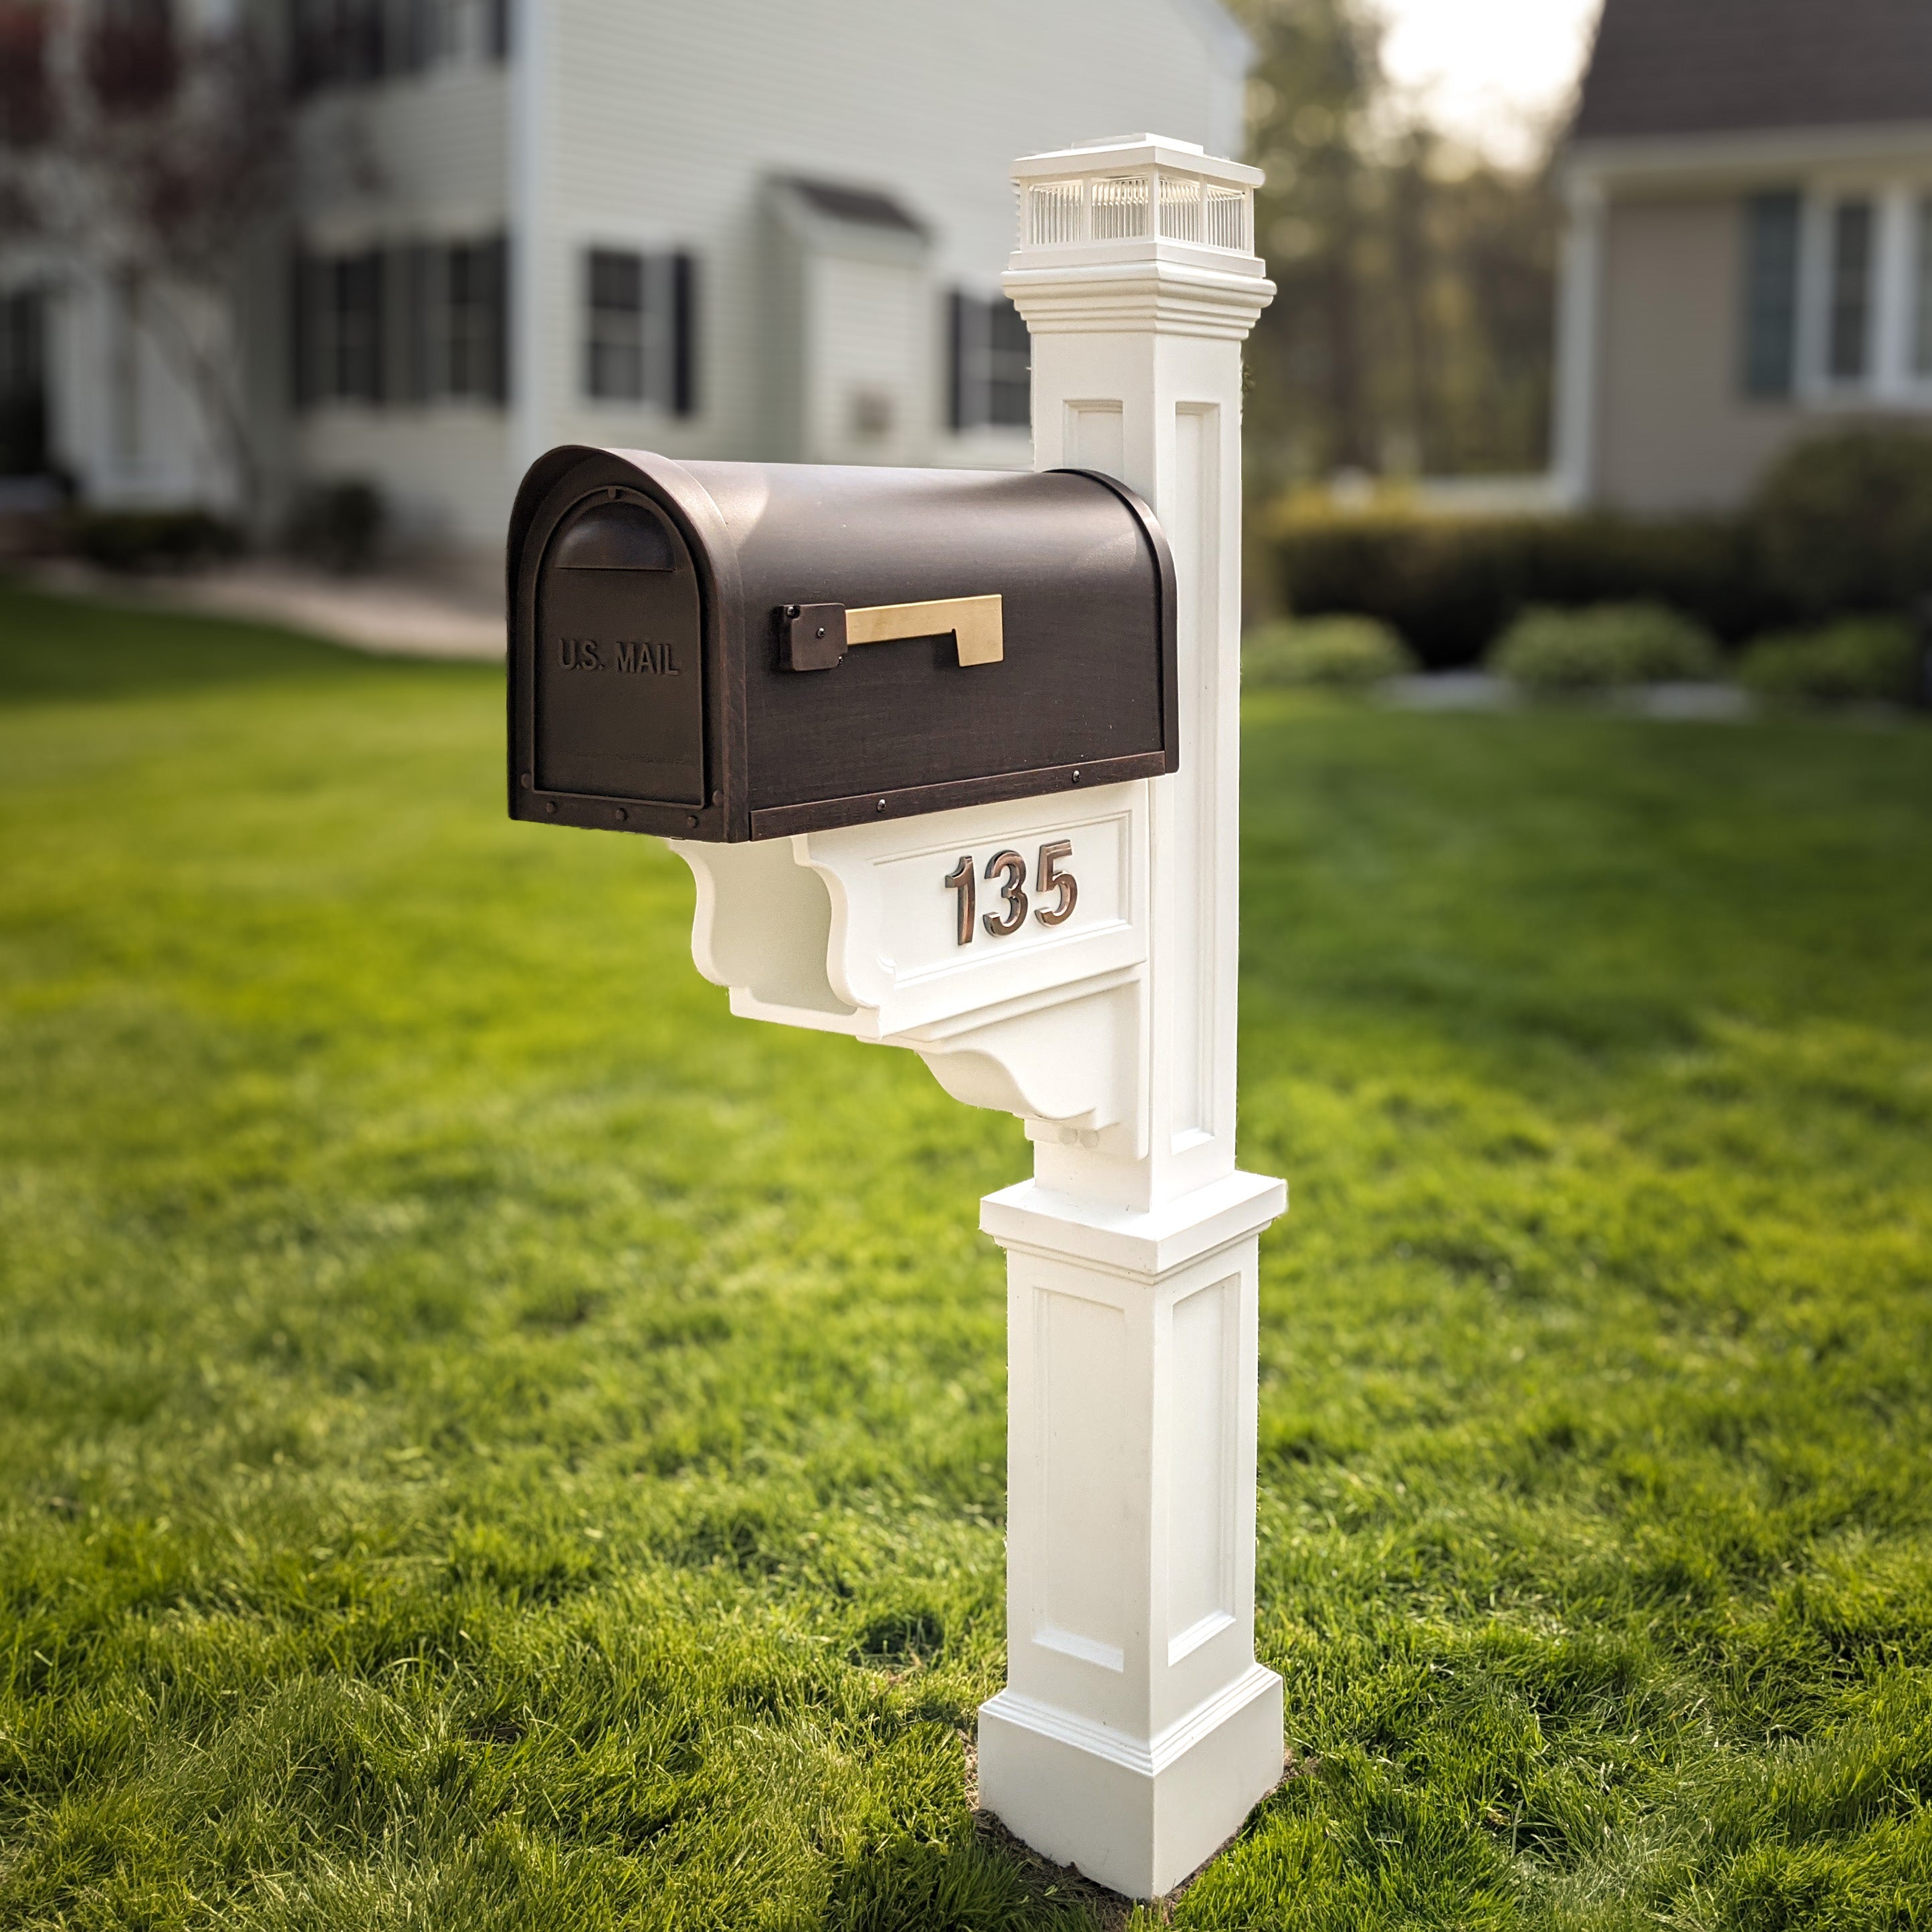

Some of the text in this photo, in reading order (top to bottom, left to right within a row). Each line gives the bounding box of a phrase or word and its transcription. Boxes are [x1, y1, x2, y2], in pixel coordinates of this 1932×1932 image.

[559, 638, 679, 675] U.S. MAIL
[945, 839, 1077, 946] 135
